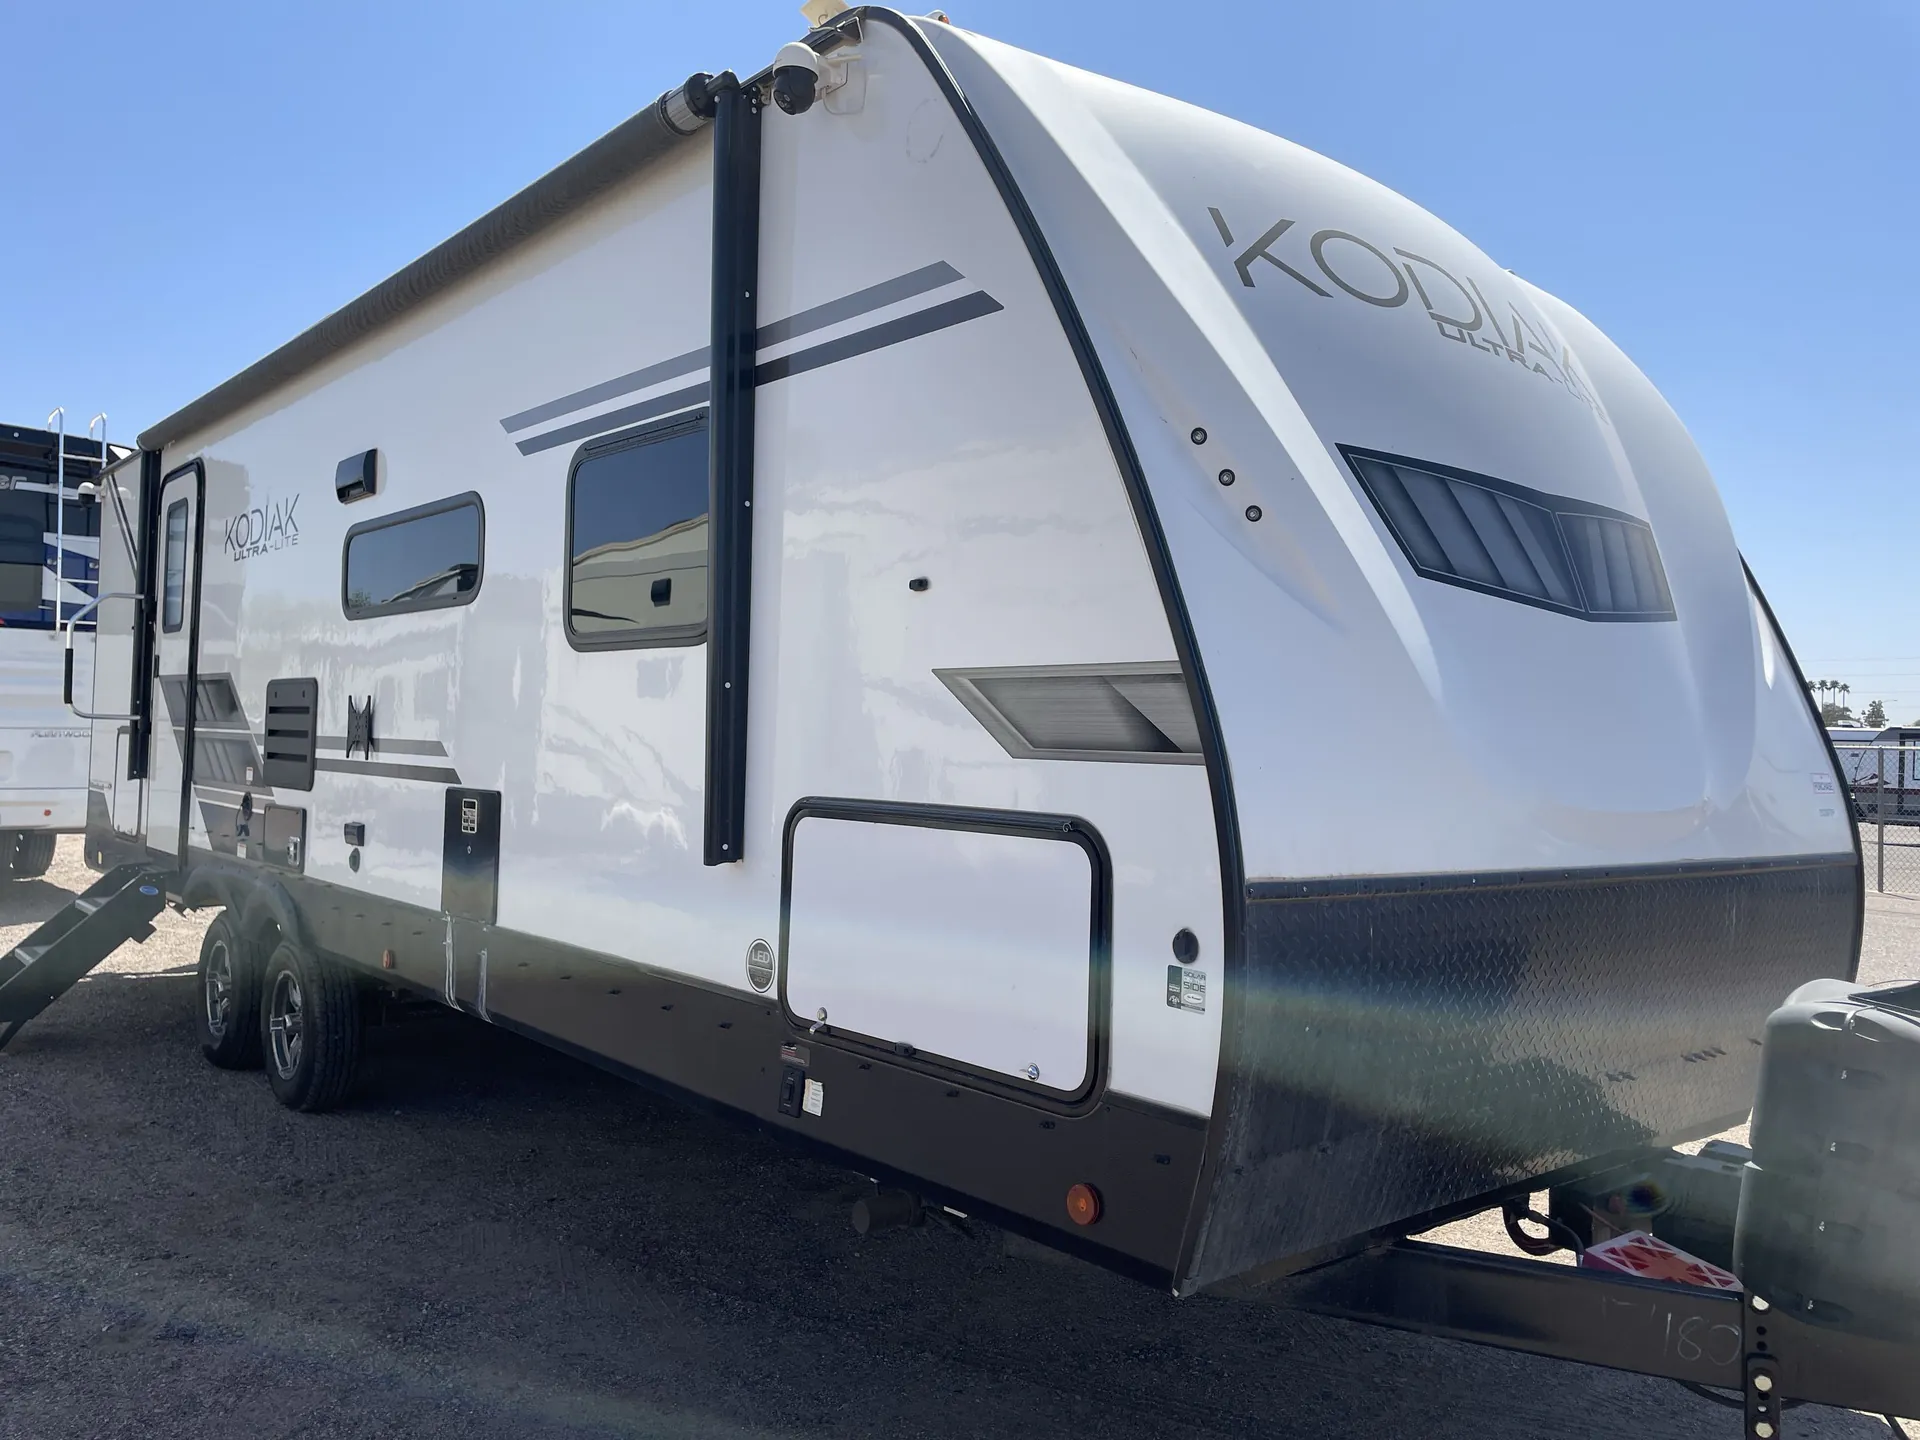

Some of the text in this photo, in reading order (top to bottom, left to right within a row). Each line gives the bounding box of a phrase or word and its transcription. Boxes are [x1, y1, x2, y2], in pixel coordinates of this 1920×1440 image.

[1207, 206, 1598, 405] KODIAK
[224, 493, 300, 554] KODIAK
[233, 533, 299, 562] ULTRA-LITE
[752, 949, 770, 964] LED
[1183, 971, 1206, 981] SOLAR
[1183, 981, 1206, 994] SIDE
